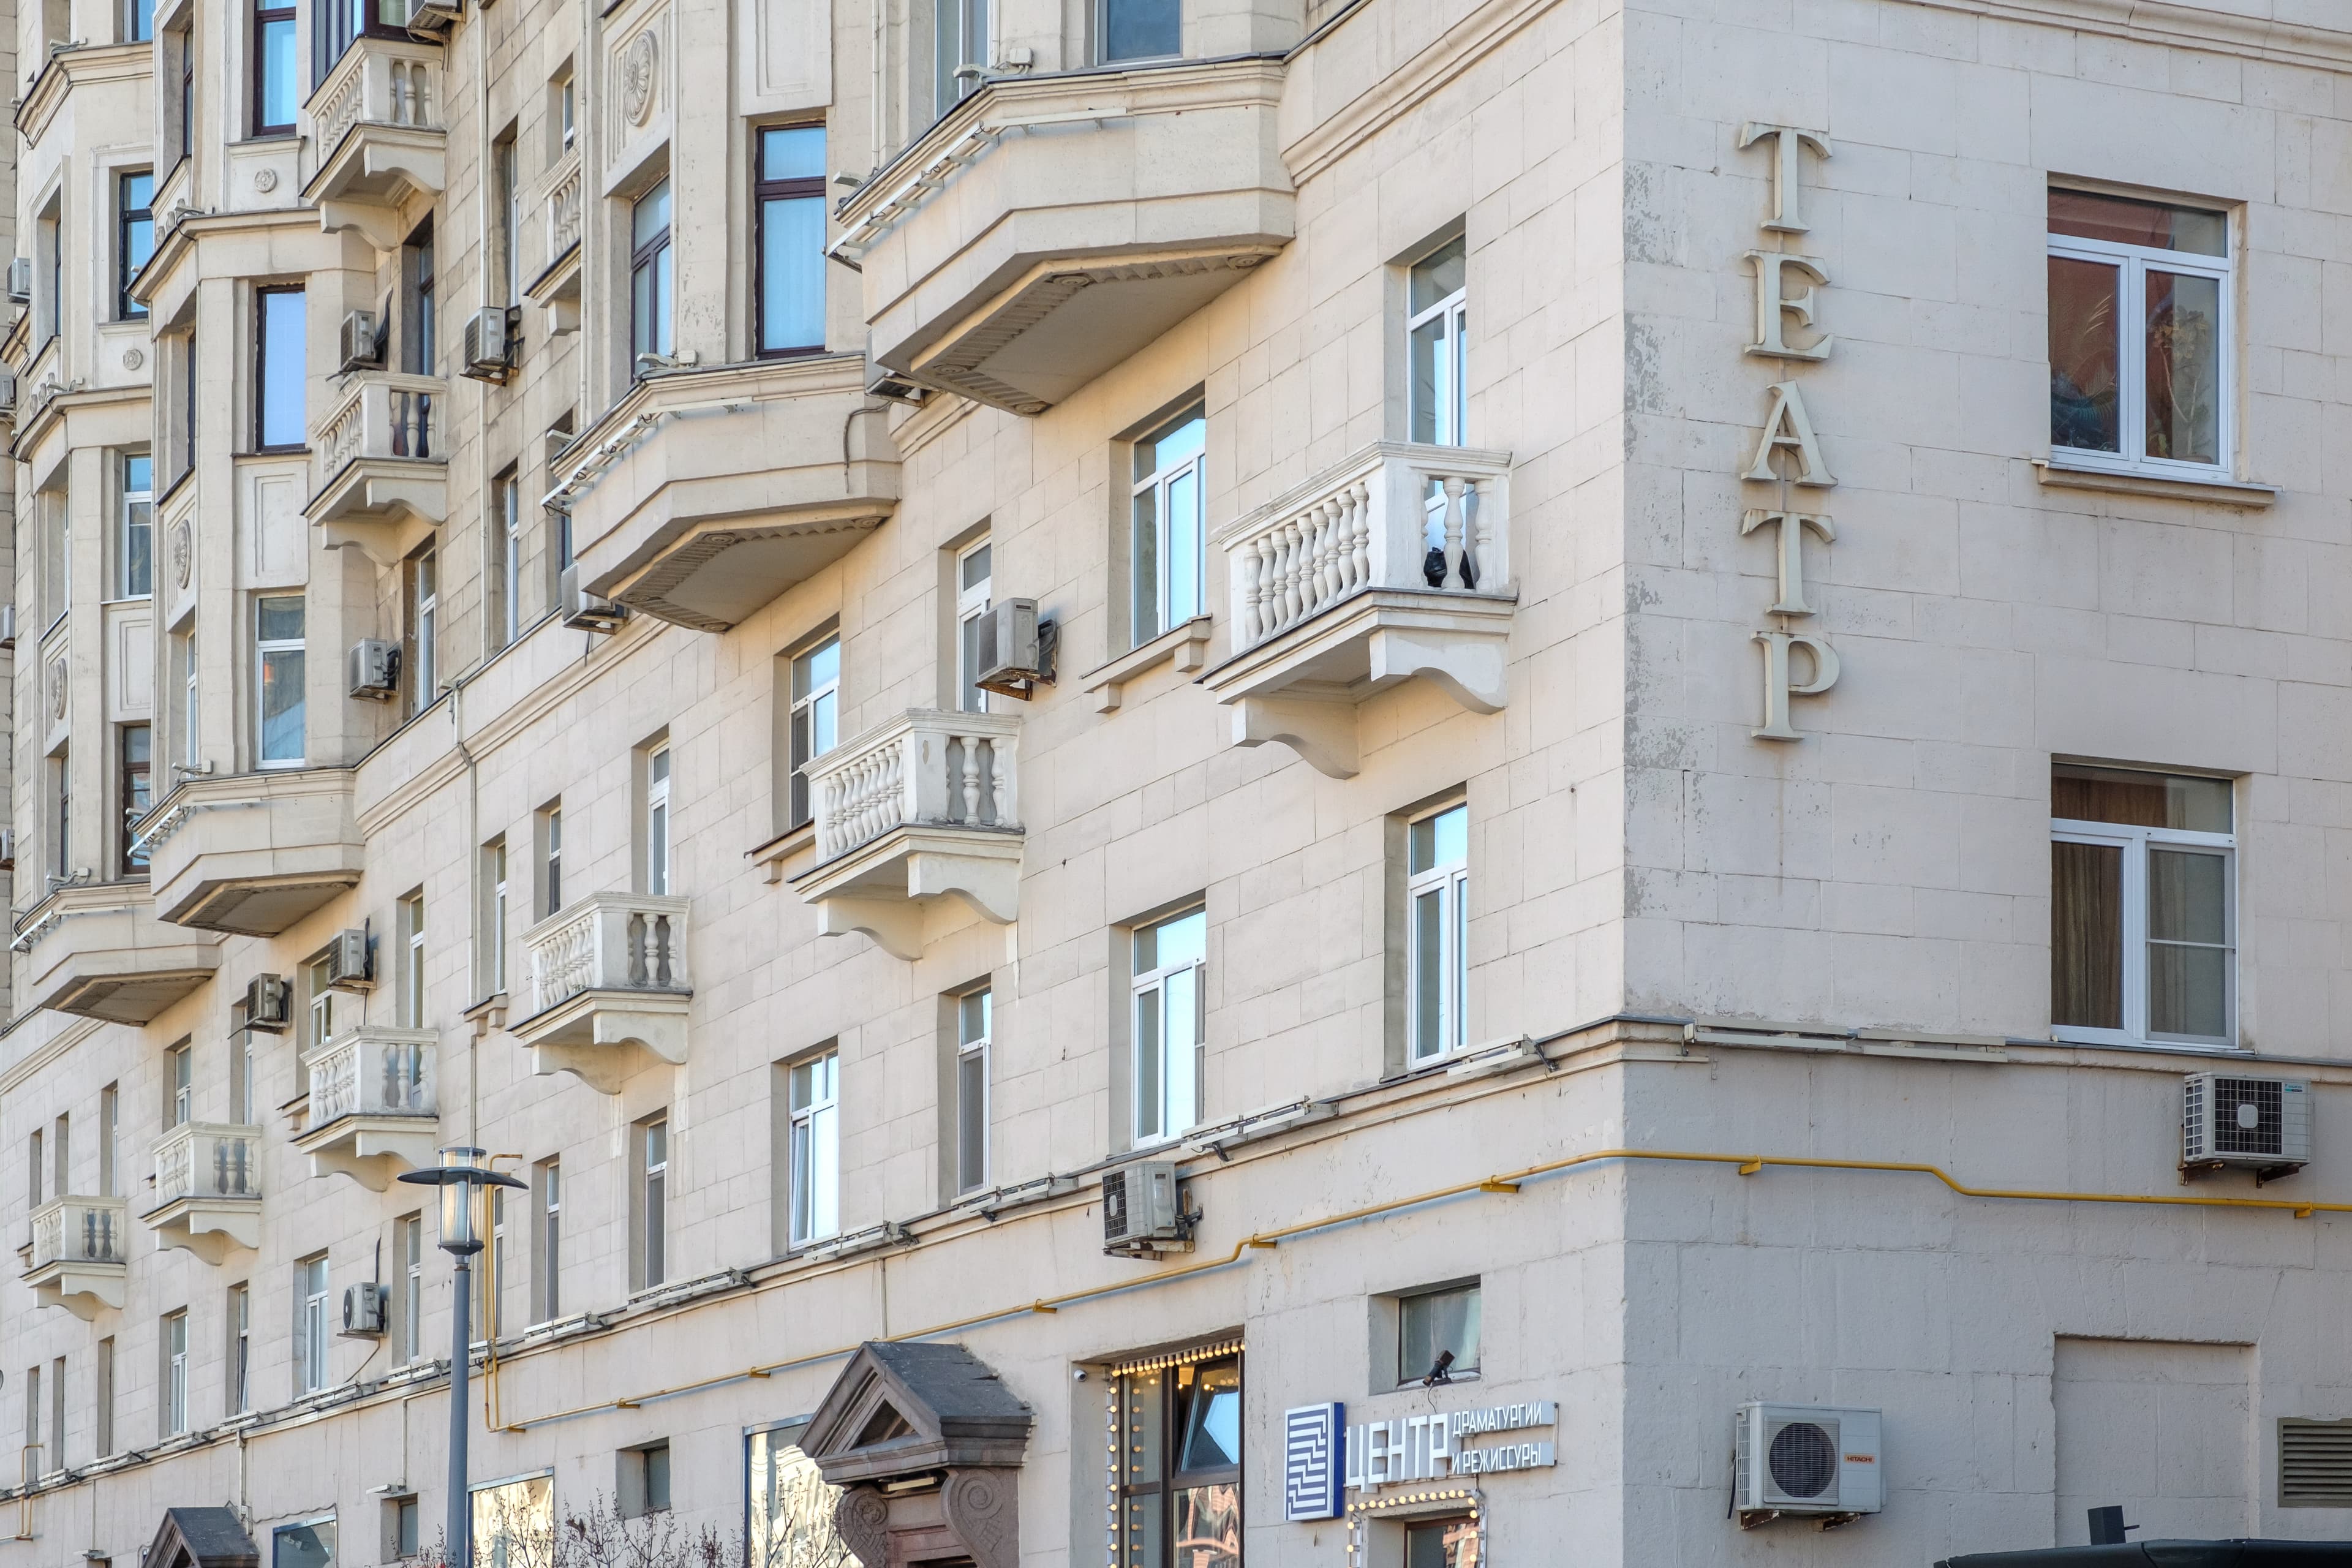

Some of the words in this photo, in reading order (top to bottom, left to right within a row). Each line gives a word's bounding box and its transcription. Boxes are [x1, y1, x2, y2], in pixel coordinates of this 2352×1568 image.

[1738, 122, 1840, 741] ТЕАТР
[1453, 1401, 1542, 1438] ДРАМАТУРГИИ
[1346, 1413, 1448, 1493] ЦЕНТР
[1452, 1452, 1460, 1474] И
[1463, 1442, 1541, 1474] РЕЖИССУРЫ
